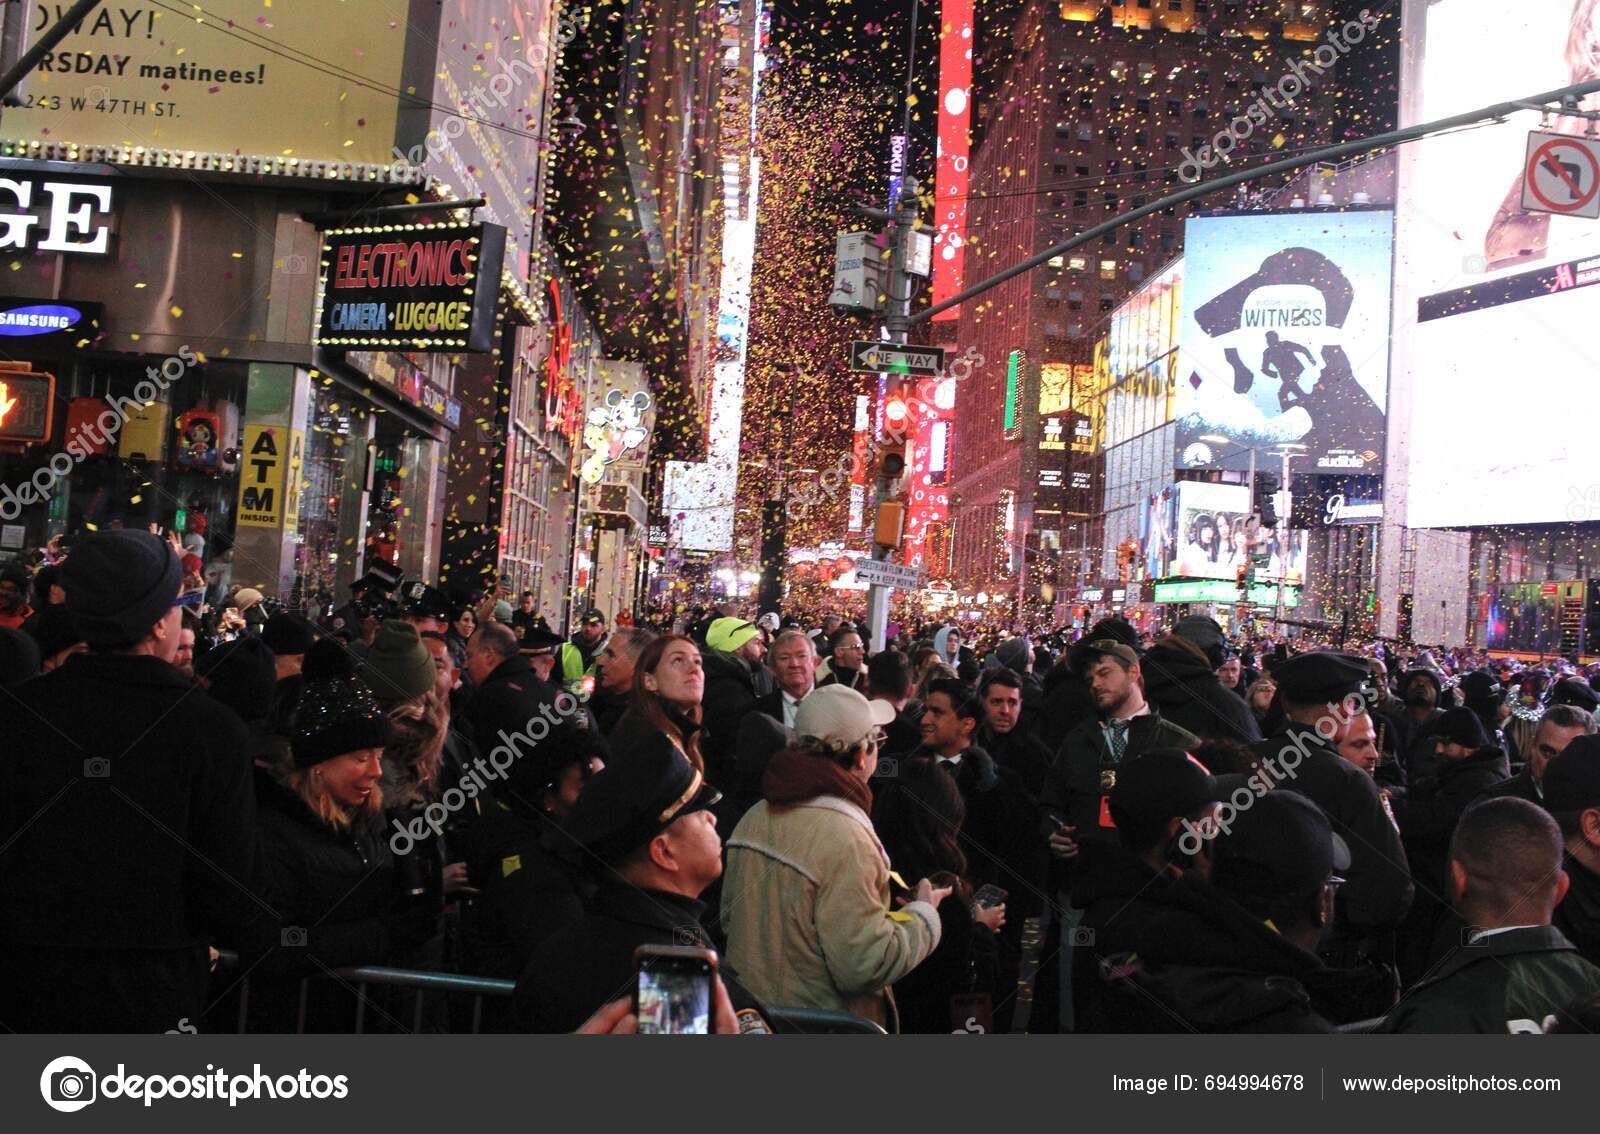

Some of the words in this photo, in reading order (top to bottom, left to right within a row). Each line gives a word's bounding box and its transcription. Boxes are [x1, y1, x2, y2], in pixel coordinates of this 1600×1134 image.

[140, 62, 265, 84] matinees!
[70, 97, 87, 112] W
[95, 98, 146, 116] 47TH
[154, 102, 181, 118] ST.
[334, 239, 475, 289] ELECTRONICS
[0, 312, 69, 329] SAMSUNG
[331, 302, 387, 331] CAMERA
[394, 301, 468, 331] LUGGAGE
[1245, 308, 1322, 327] WITNESS
[866, 351, 893, 365] ONE
[904, 353, 933, 367] WAY
[242, 431, 278, 512] ATM
[241, 513, 276, 523] INSIDE
